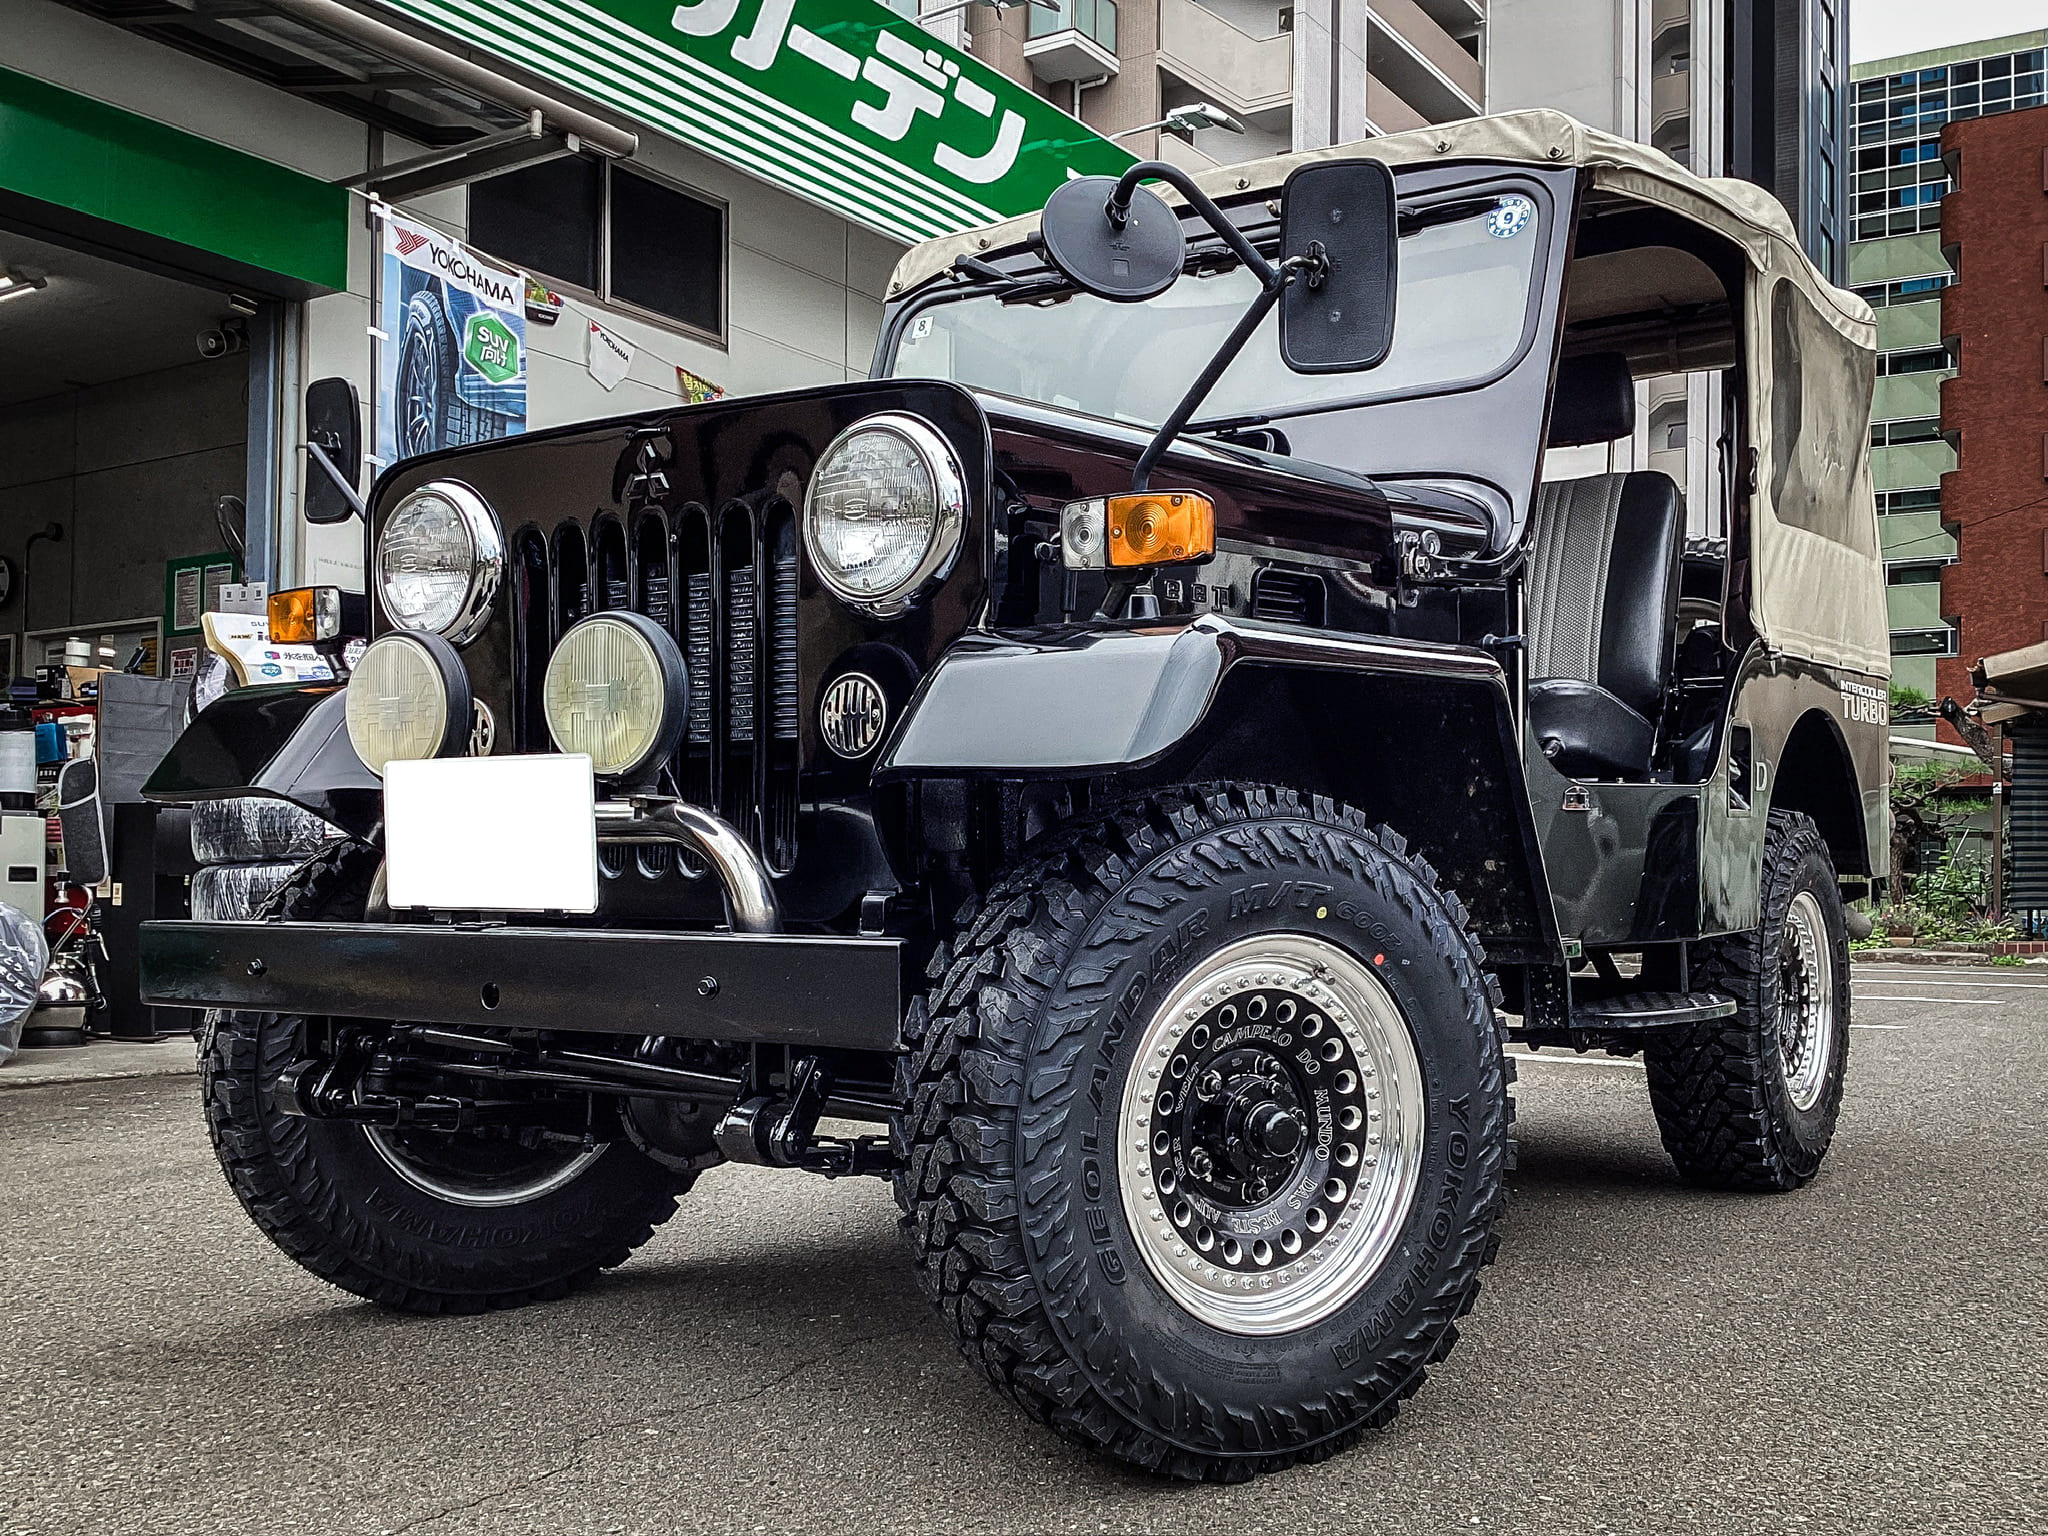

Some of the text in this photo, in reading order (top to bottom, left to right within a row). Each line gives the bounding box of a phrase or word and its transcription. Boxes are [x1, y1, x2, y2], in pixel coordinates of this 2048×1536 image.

[1503, 212, 1514, 225] 9
[429, 242, 515, 305] YOKOHAMA
[477, 325, 509, 351] SUV
[480, 342, 507, 368] 向け
[599, 332, 630, 363] YOKOHAMA
[1840, 679, 1887, 702] INTERCOOLER
[1840, 692, 1888, 726] TURBO
[1081, 907, 1211, 1286] GEOLANDAR
[1227, 880, 1335, 923] M/T
[1335, 900, 1404, 952] G003
[1174, 1061, 1201, 1114] WELT
[1296, 1048, 1321, 1075] DO
[1313, 1088, 1334, 1162] MUNDO
[1287, 1175, 1318, 1210] DAS
[1231, 1208, 1283, 1235] BESTE
[1330, 1093, 1471, 1371] YOKOHAMA
